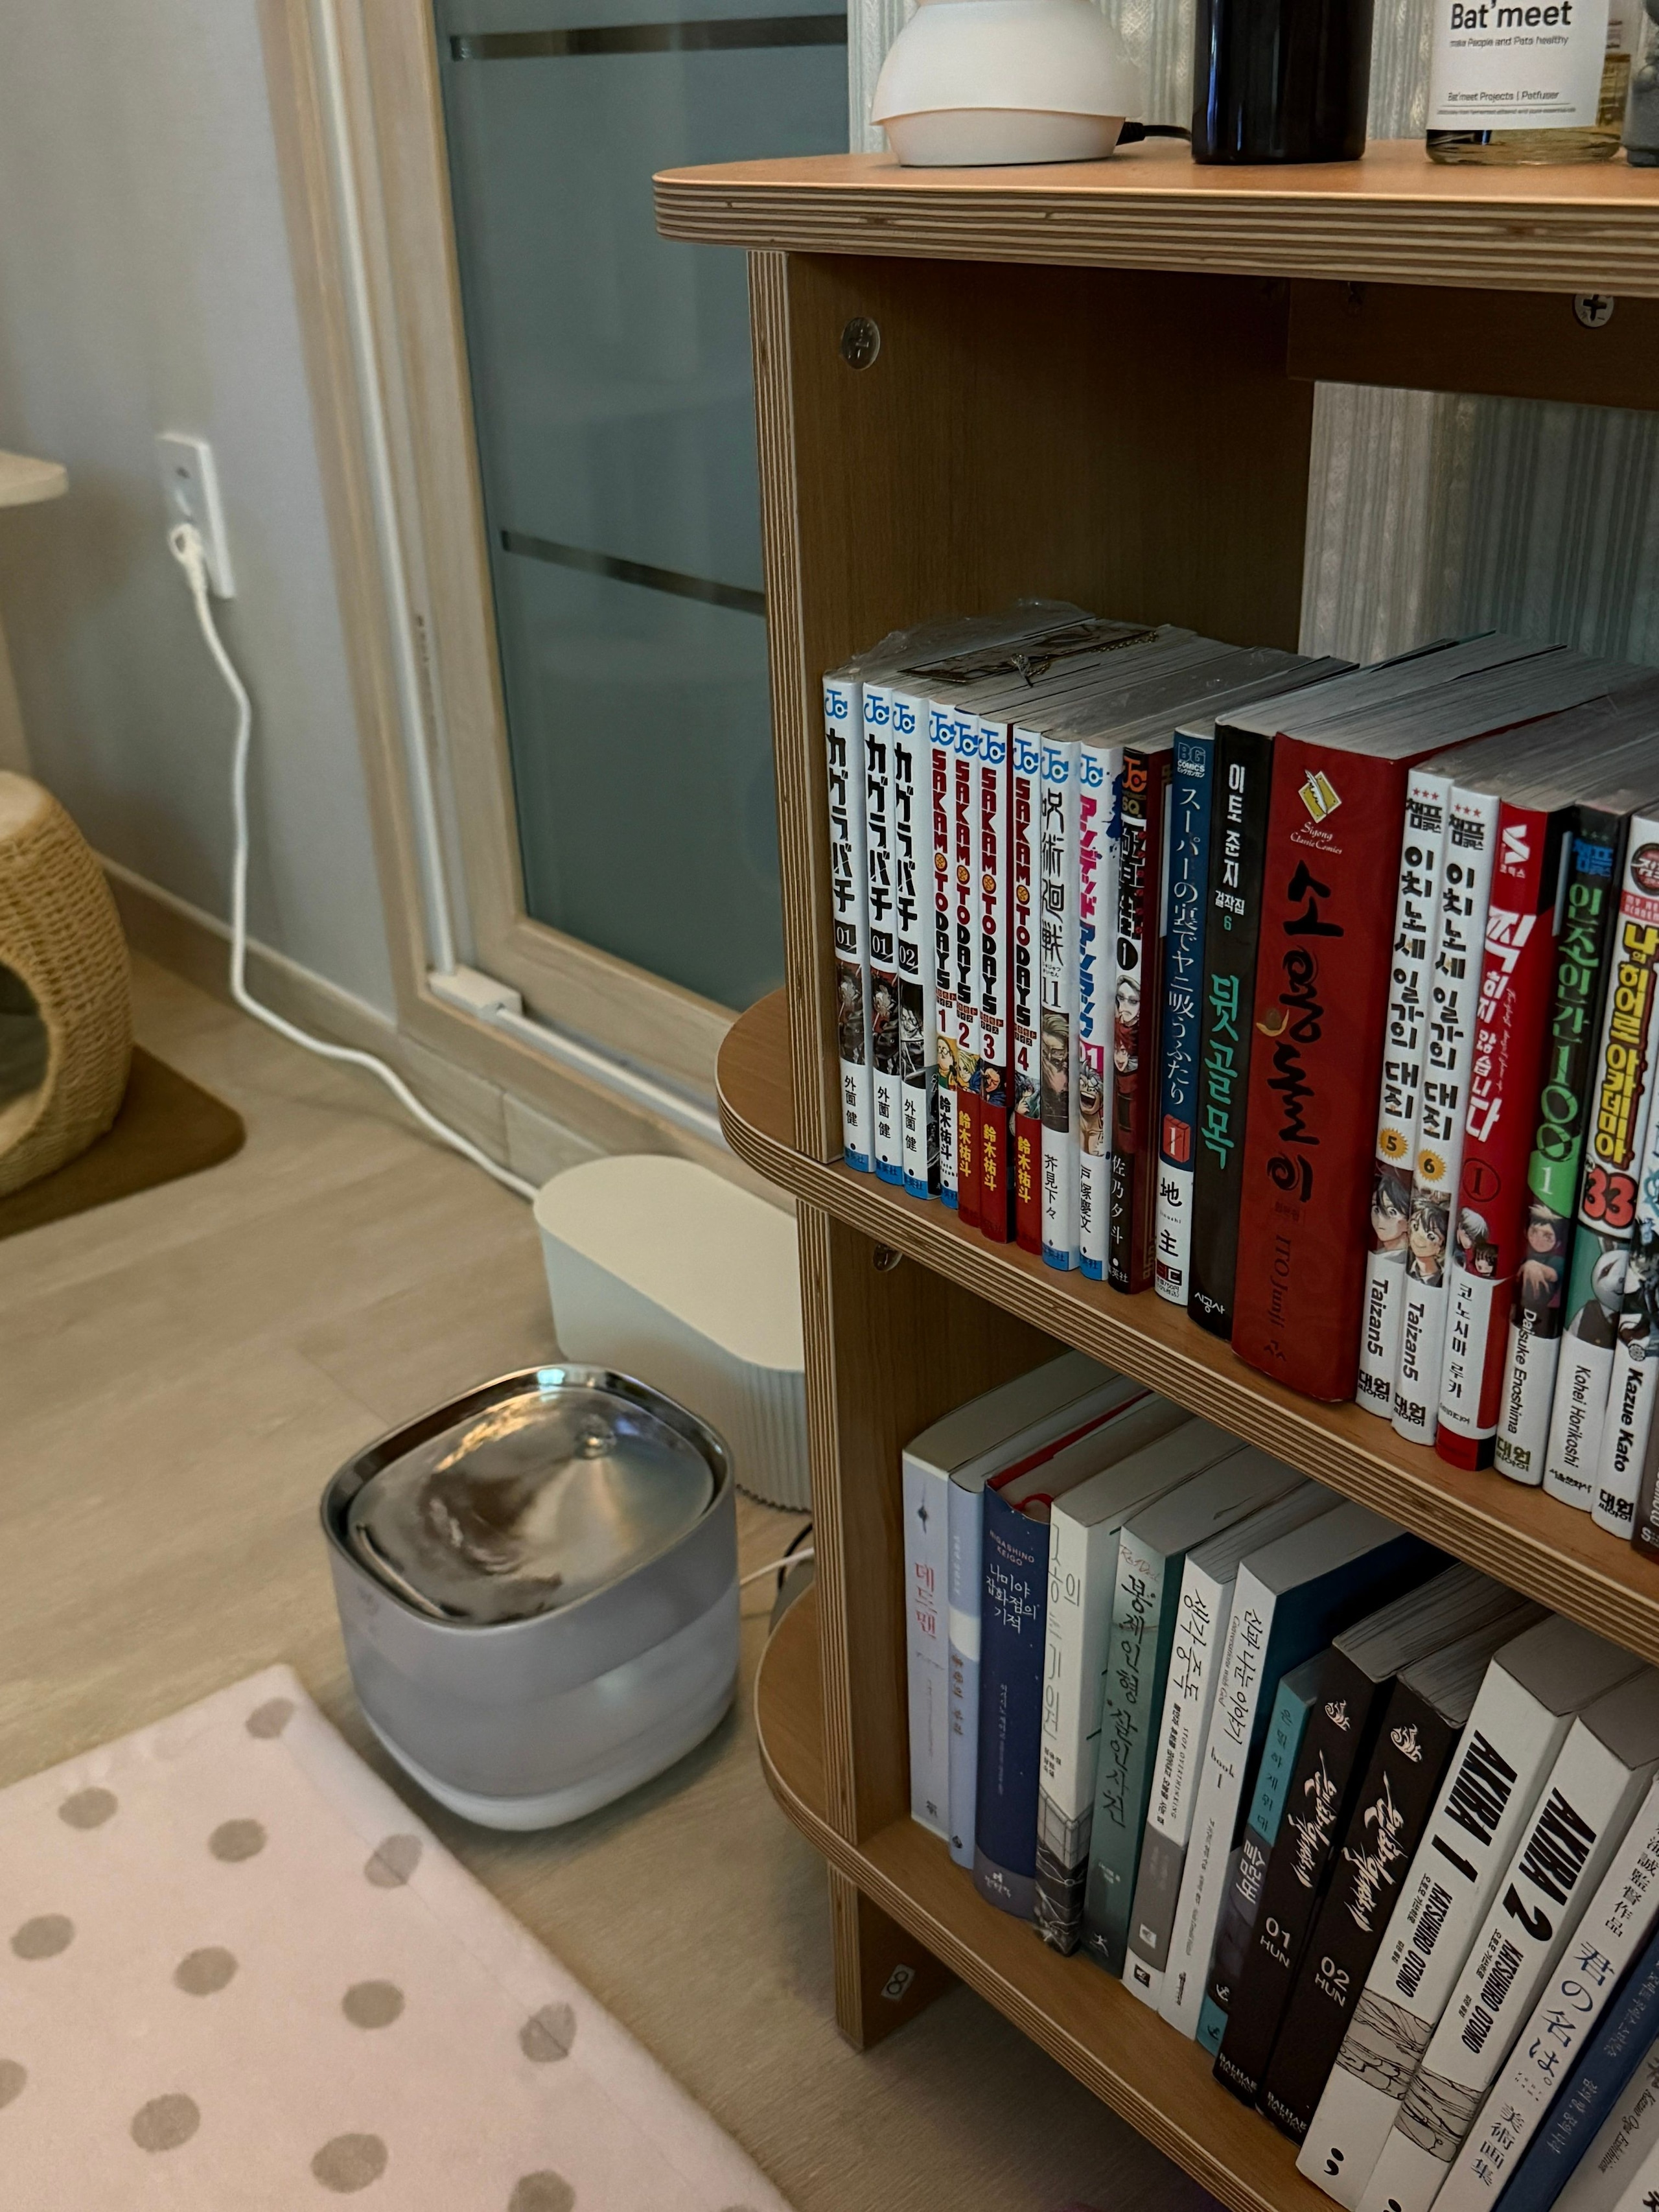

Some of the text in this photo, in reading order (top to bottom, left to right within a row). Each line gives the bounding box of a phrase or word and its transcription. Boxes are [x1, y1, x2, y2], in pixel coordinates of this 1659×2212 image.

[1451, 0, 1572, 30] Bat'meet
[1480, 92, 1514, 102] Projects
[1178, 760, 1205, 773] COMICS
[826, 728, 855, 913] カグラバチ
[865, 734, 892, 921] カグラバチ
[894, 742, 918, 931] カグラバチ
[1223, 763, 1246, 888] 이토 준지
[837, 927, 852, 946] 01
[1224, 915, 1232, 931] 6
[872, 935, 888, 955] 01
[899, 946, 915, 966] 02
[1043, 977, 1061, 1008] 11
[1610, 963, 1649, 1044] 히어로
[938, 1009, 946, 1032] 1
[958, 1022, 970, 1048] 2
[984, 1034, 995, 1059] 3
[1017, 1047, 1029, 1071] 4
[1201, 974, 1239, 1169] 뒷골목
[1595, 1043, 1639, 1163] 아카데미아
[1386, 1136, 1397, 1152] 5
[1424, 1158, 1435, 1174] 6
[1540, 1167, 1553, 1194] 1
[1045, 1154, 1058, 1220] 芥見下々
[1111, 1156, 1126, 1245] 佐乃夕斗
[1584, 1168, 1634, 1227] 33
[1195, 1292, 1225, 1314] 시공사
[1367, 1279, 1389, 1357] Taizan5
[1403, 1303, 1425, 1381] Taizan5
[1448, 1283, 1472, 1399] 코노시마 루카
[1507, 1308, 1537, 1434] Daisuke Enoshima
[1564, 1365, 1592, 1468] Kohei Horikoshi
[1614, 1368, 1644, 1473] Kazue Kato
[990, 1530, 1035, 1564] HIGASHINO
[997, 1546, 1023, 1566] KEIGO
[986, 1576, 1036, 1620] 잡화점의
[990, 1563, 1031, 1599] 나미야
[994, 1607, 1021, 1634] 기적
[1173, 1589, 1210, 1701] 생각 중독
[1224, 1609, 1263, 1745] 신과 나눈 이야기
[1211, 1746, 1236, 1778] book
[1431, 1729, 1518, 1883] AKIRA 1
[1236, 1839, 1266, 1904] 슬럼버
[1502, 1787, 1597, 1942] AKIRA 2
[1260, 1935, 1290, 1968] HUN
[1266, 1916, 1291, 1950] 01
[1395, 1882, 1454, 1998] KATSUHIRO OTOMO
[1315, 1973, 1346, 2007] HUN
[1321, 1956, 1350, 1992] 02
[1461, 1938, 1525, 2055] KATSUHIRO OTOMO
[1528, 1942, 1614, 2086] 君の名は。
